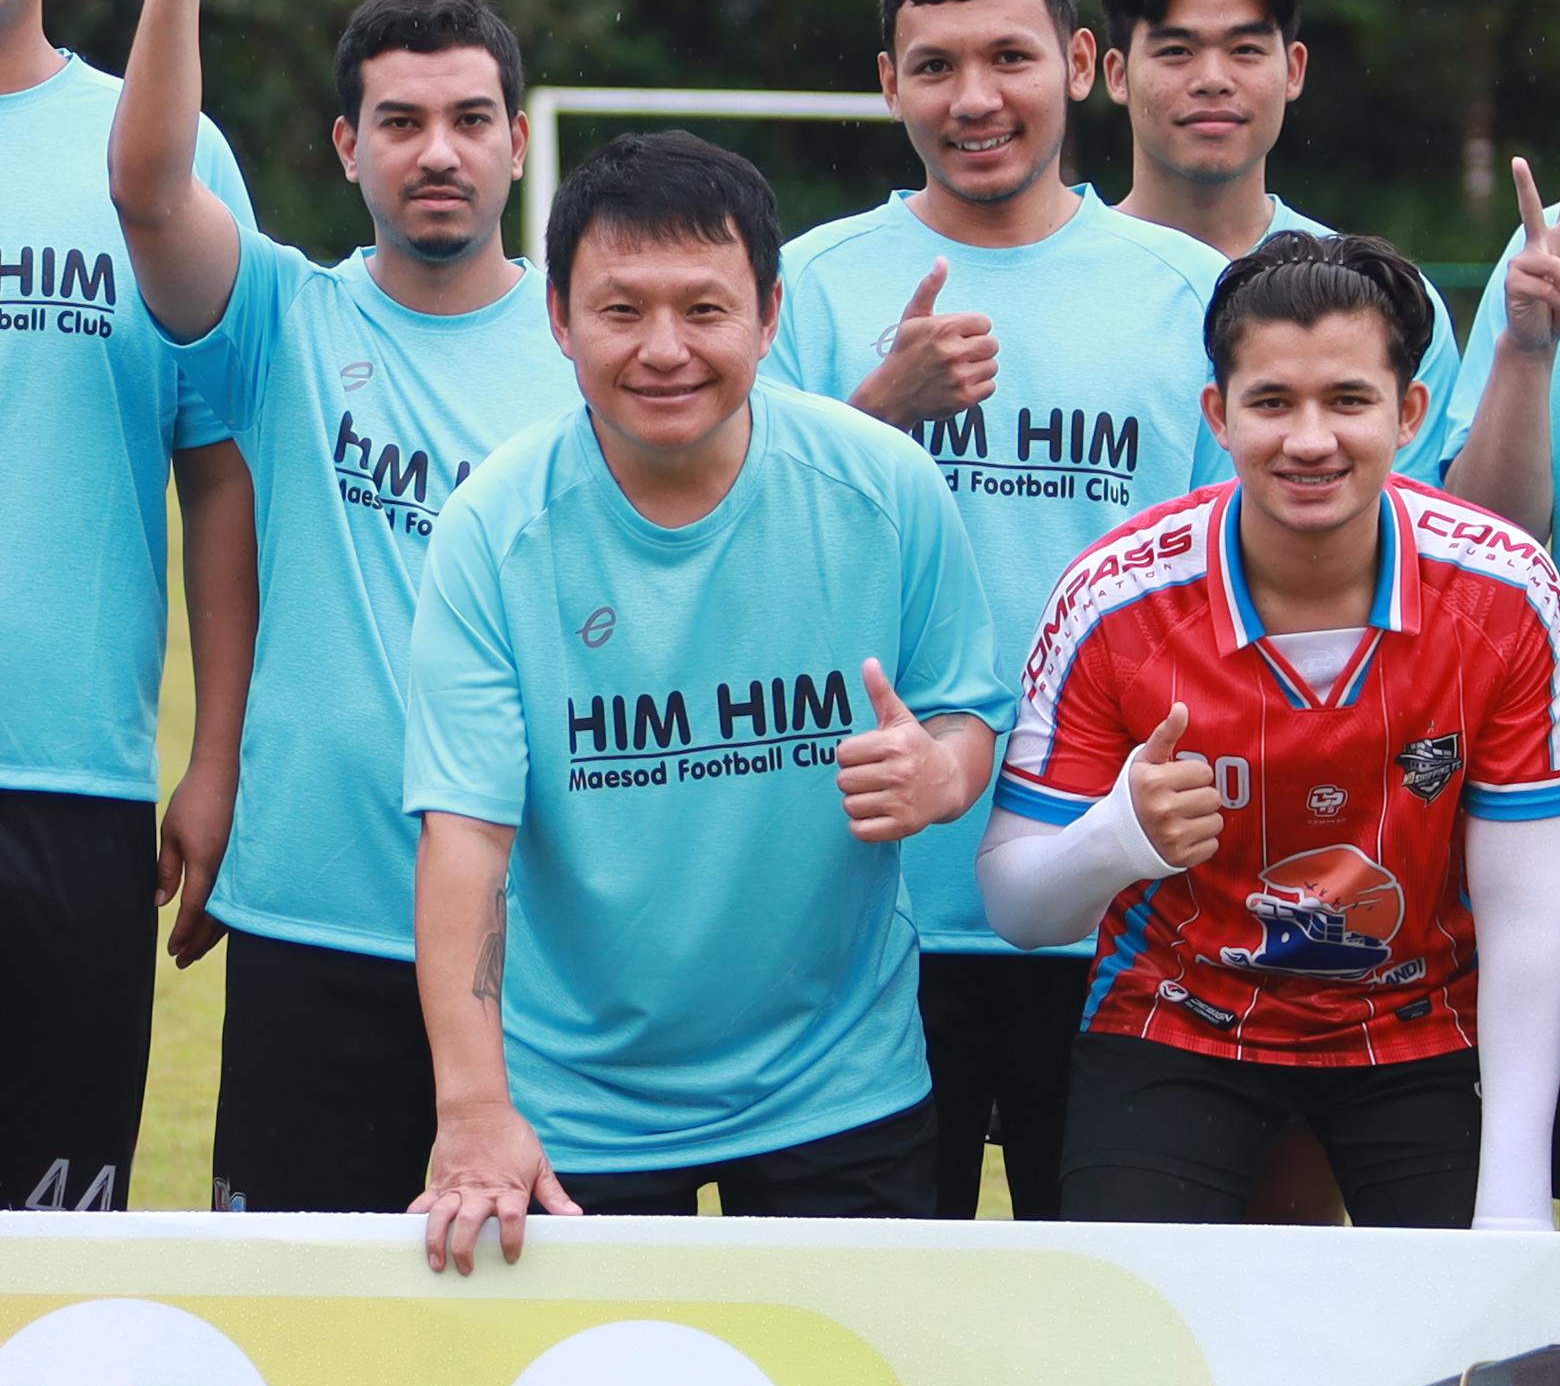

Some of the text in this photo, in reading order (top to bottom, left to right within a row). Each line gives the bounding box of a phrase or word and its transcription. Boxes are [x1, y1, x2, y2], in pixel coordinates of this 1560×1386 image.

[57, 311, 112, 338] Club
[1018, 407, 1138, 472] HIM
[971, 472, 1074, 499] Football
[1086, 478, 1129, 506] Club
[568, 670, 852, 754] HIM HIM
[569, 739, 842, 792] Maesod Football Clu
